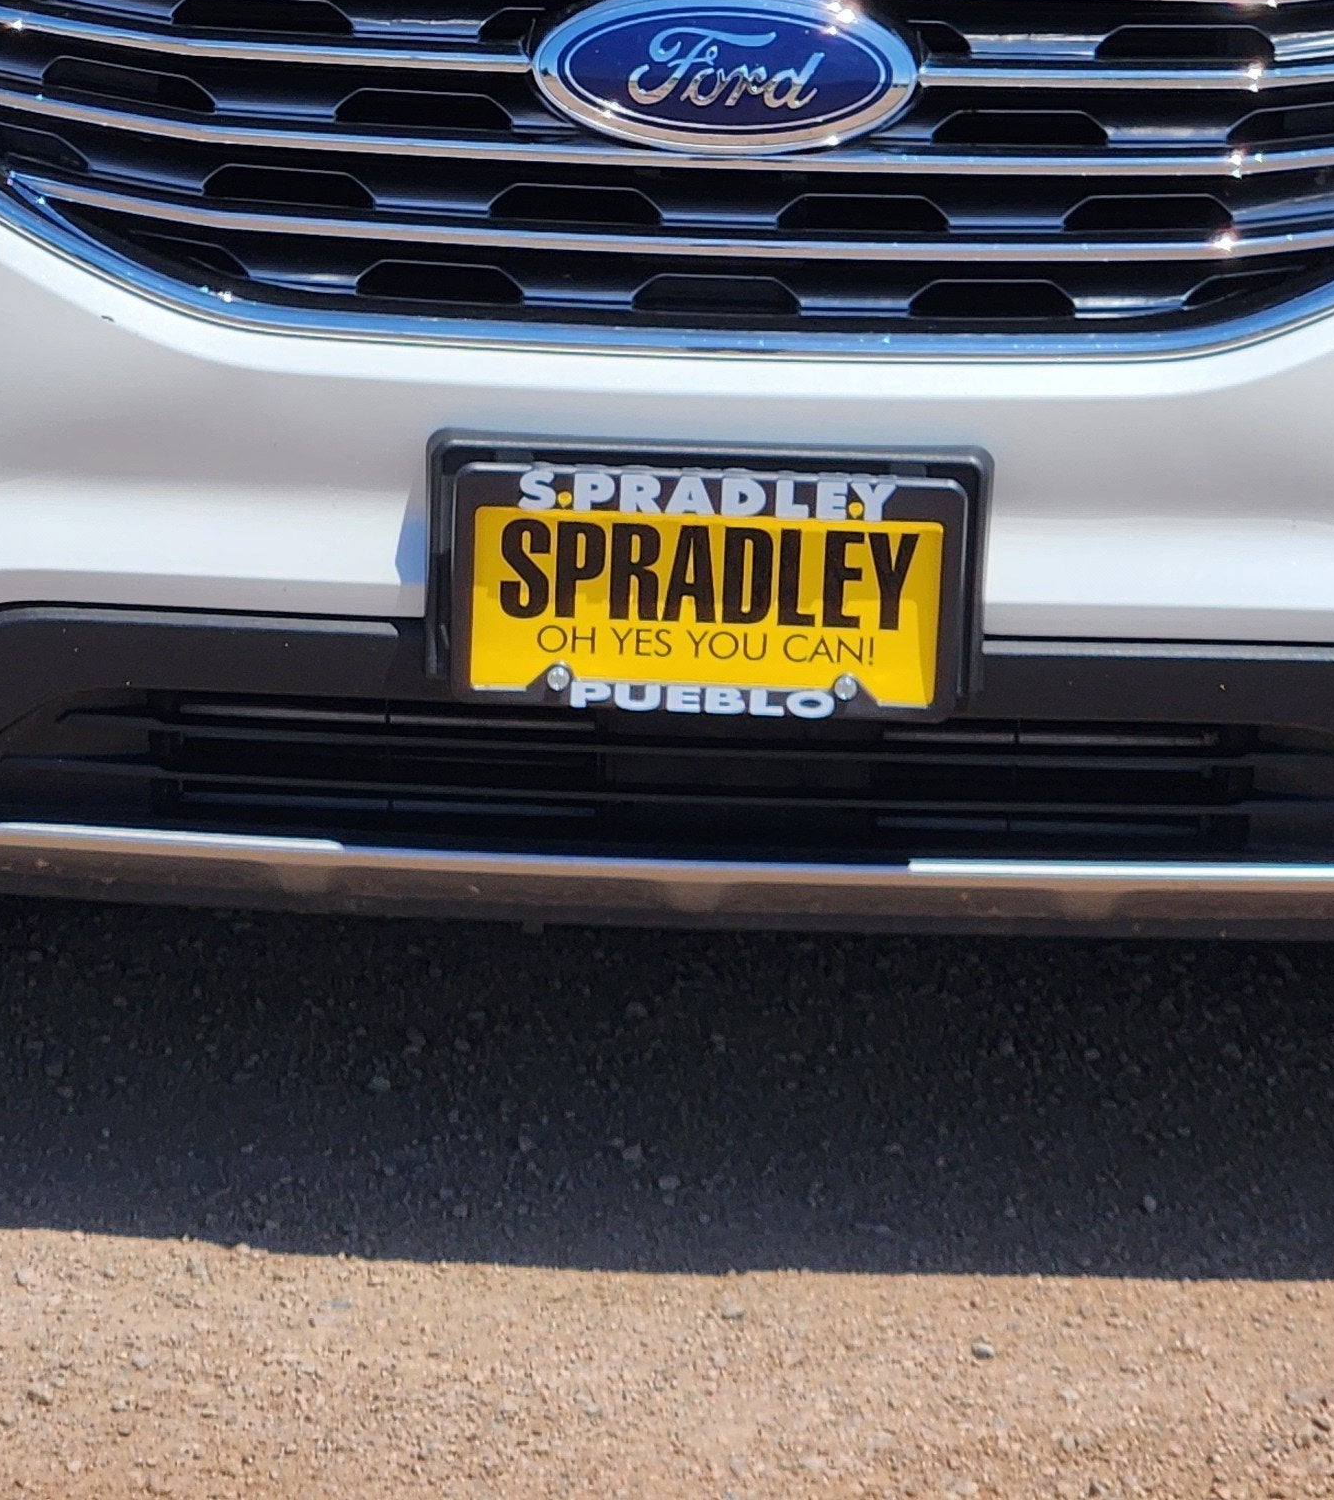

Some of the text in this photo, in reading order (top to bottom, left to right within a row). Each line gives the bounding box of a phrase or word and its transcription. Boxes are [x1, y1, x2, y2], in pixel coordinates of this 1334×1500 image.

[627, 26, 826, 110] Ford
[518, 470, 897, 521] SPRADLEY
[499, 519, 918, 630] SPRADLEY
[537, 624, 875, 666] OH YES YOU CAN!
[570, 681, 836, 718] PUEBLO
